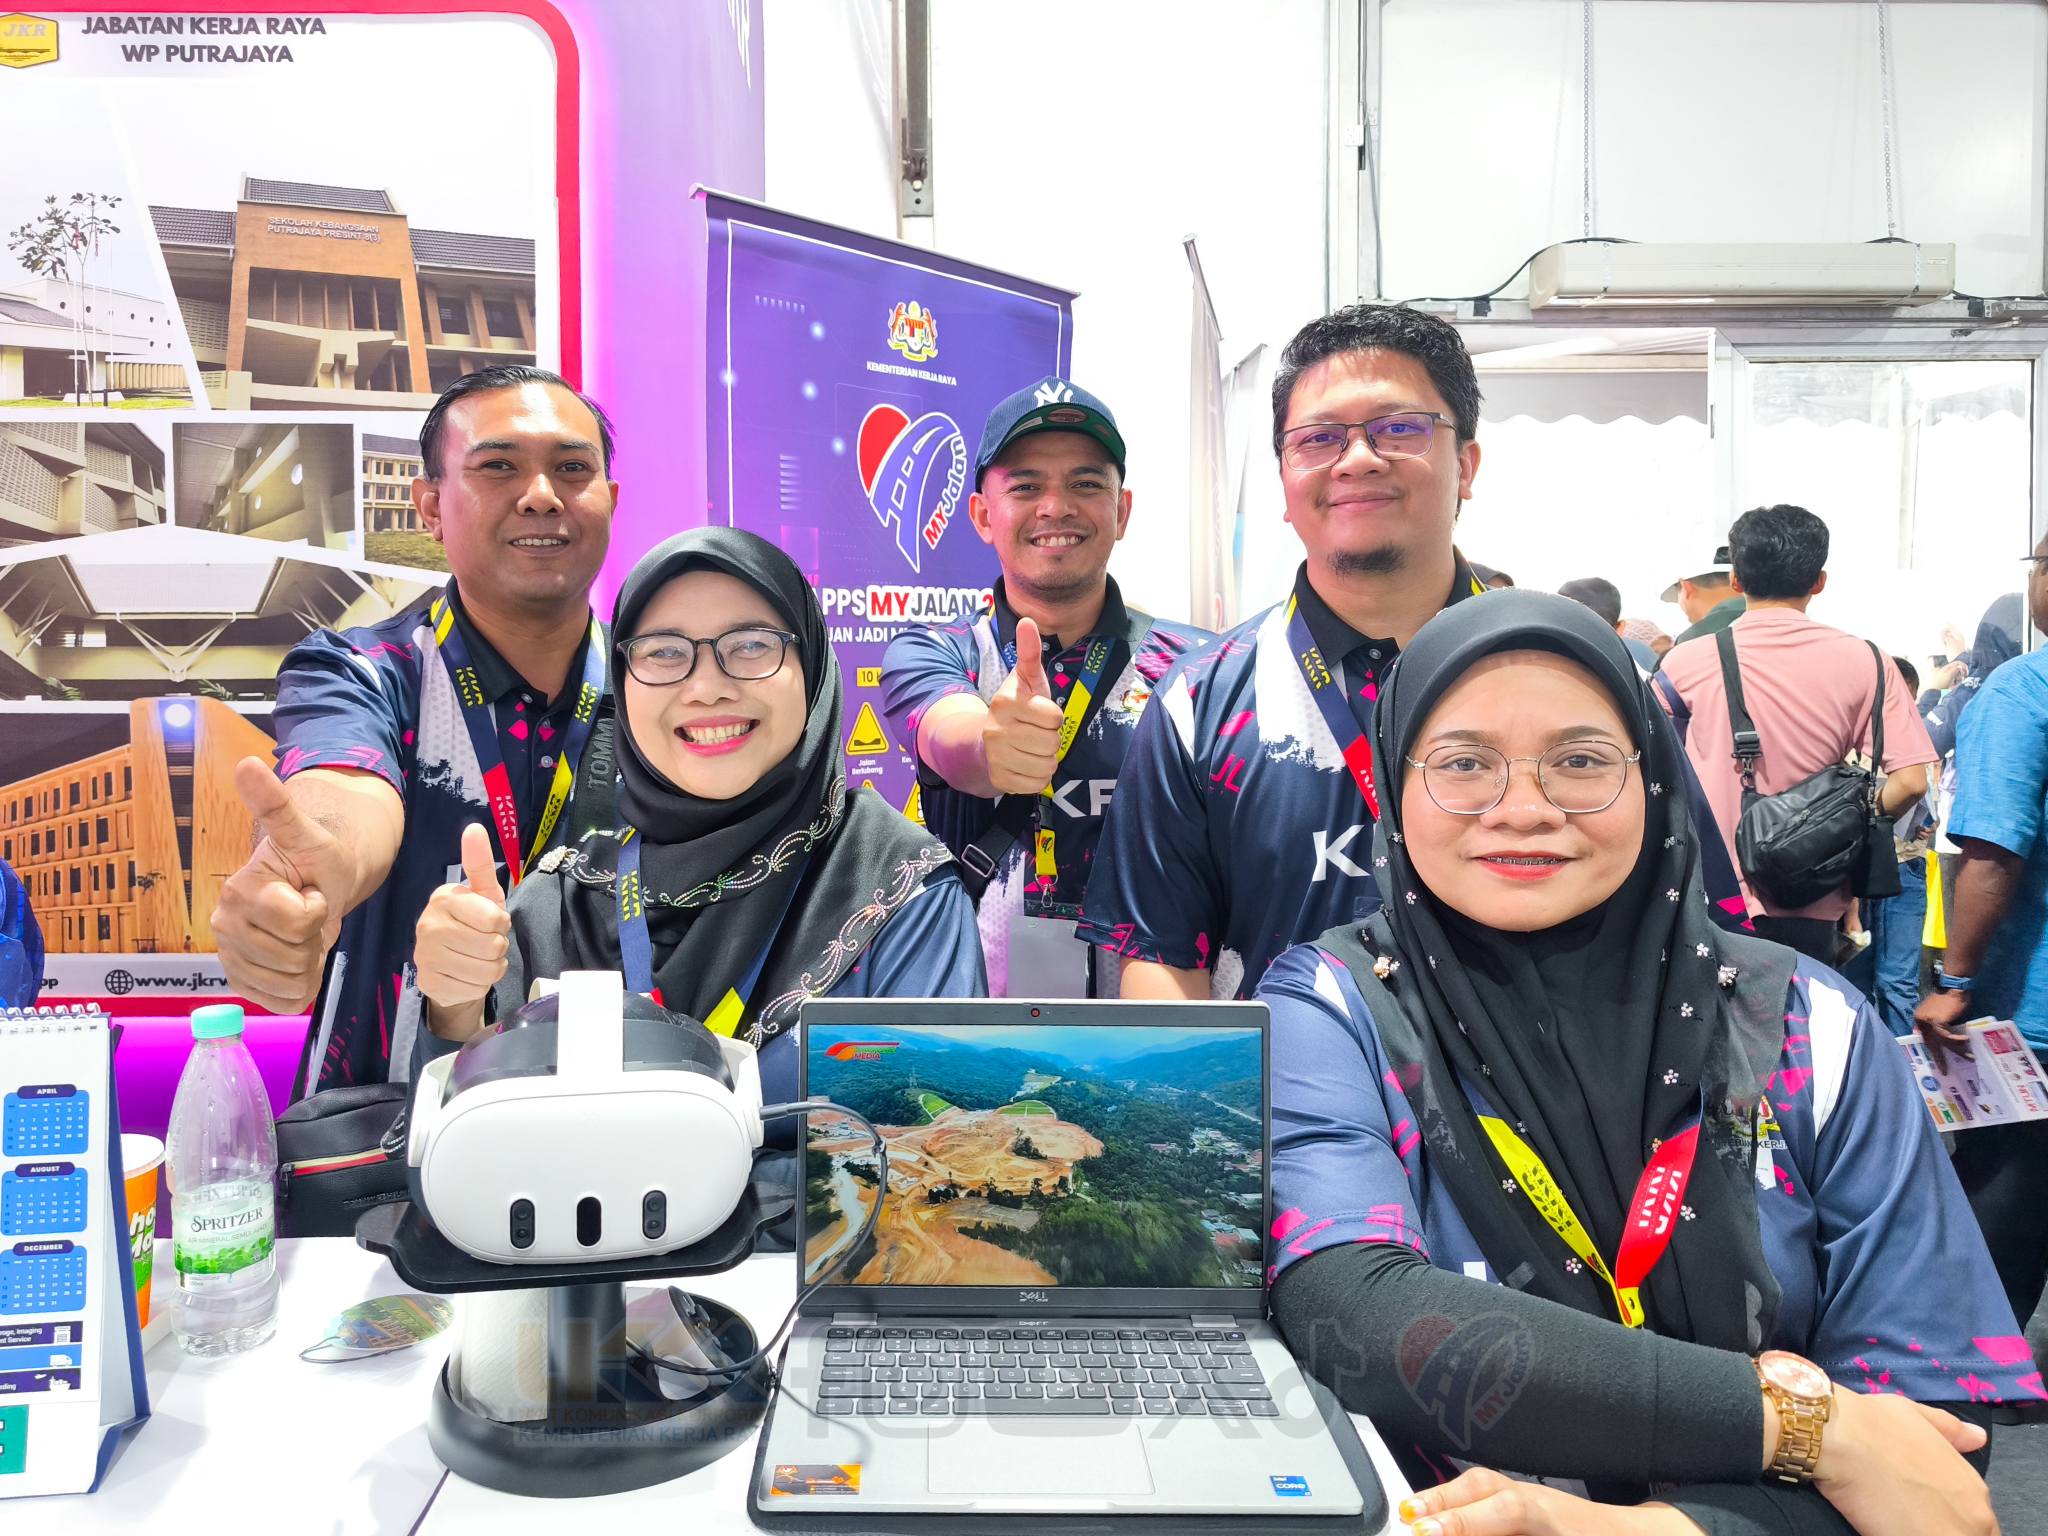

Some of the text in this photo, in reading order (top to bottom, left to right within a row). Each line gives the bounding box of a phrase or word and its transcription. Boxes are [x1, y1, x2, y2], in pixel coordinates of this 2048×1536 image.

[3, 23, 47, 37] JKR
[81, 16, 327, 35] JABATAN KERJA RAYA
[121, 44, 294, 63] WP PUTRAJAYA
[267, 224, 321, 236] PUTRAJAYA
[323, 230, 361, 240] PRESINT
[268, 216, 379, 233] SEKOLAH KEBANGSAAN
[866, 360, 957, 386] KEMENTERIAN KERJA RAYA
[855, 627, 888, 642] JADI
[862, 671, 873, 683] 10
[858, 759, 876, 767] Jalan
[190, 1206, 263, 1233] SPRITZER
